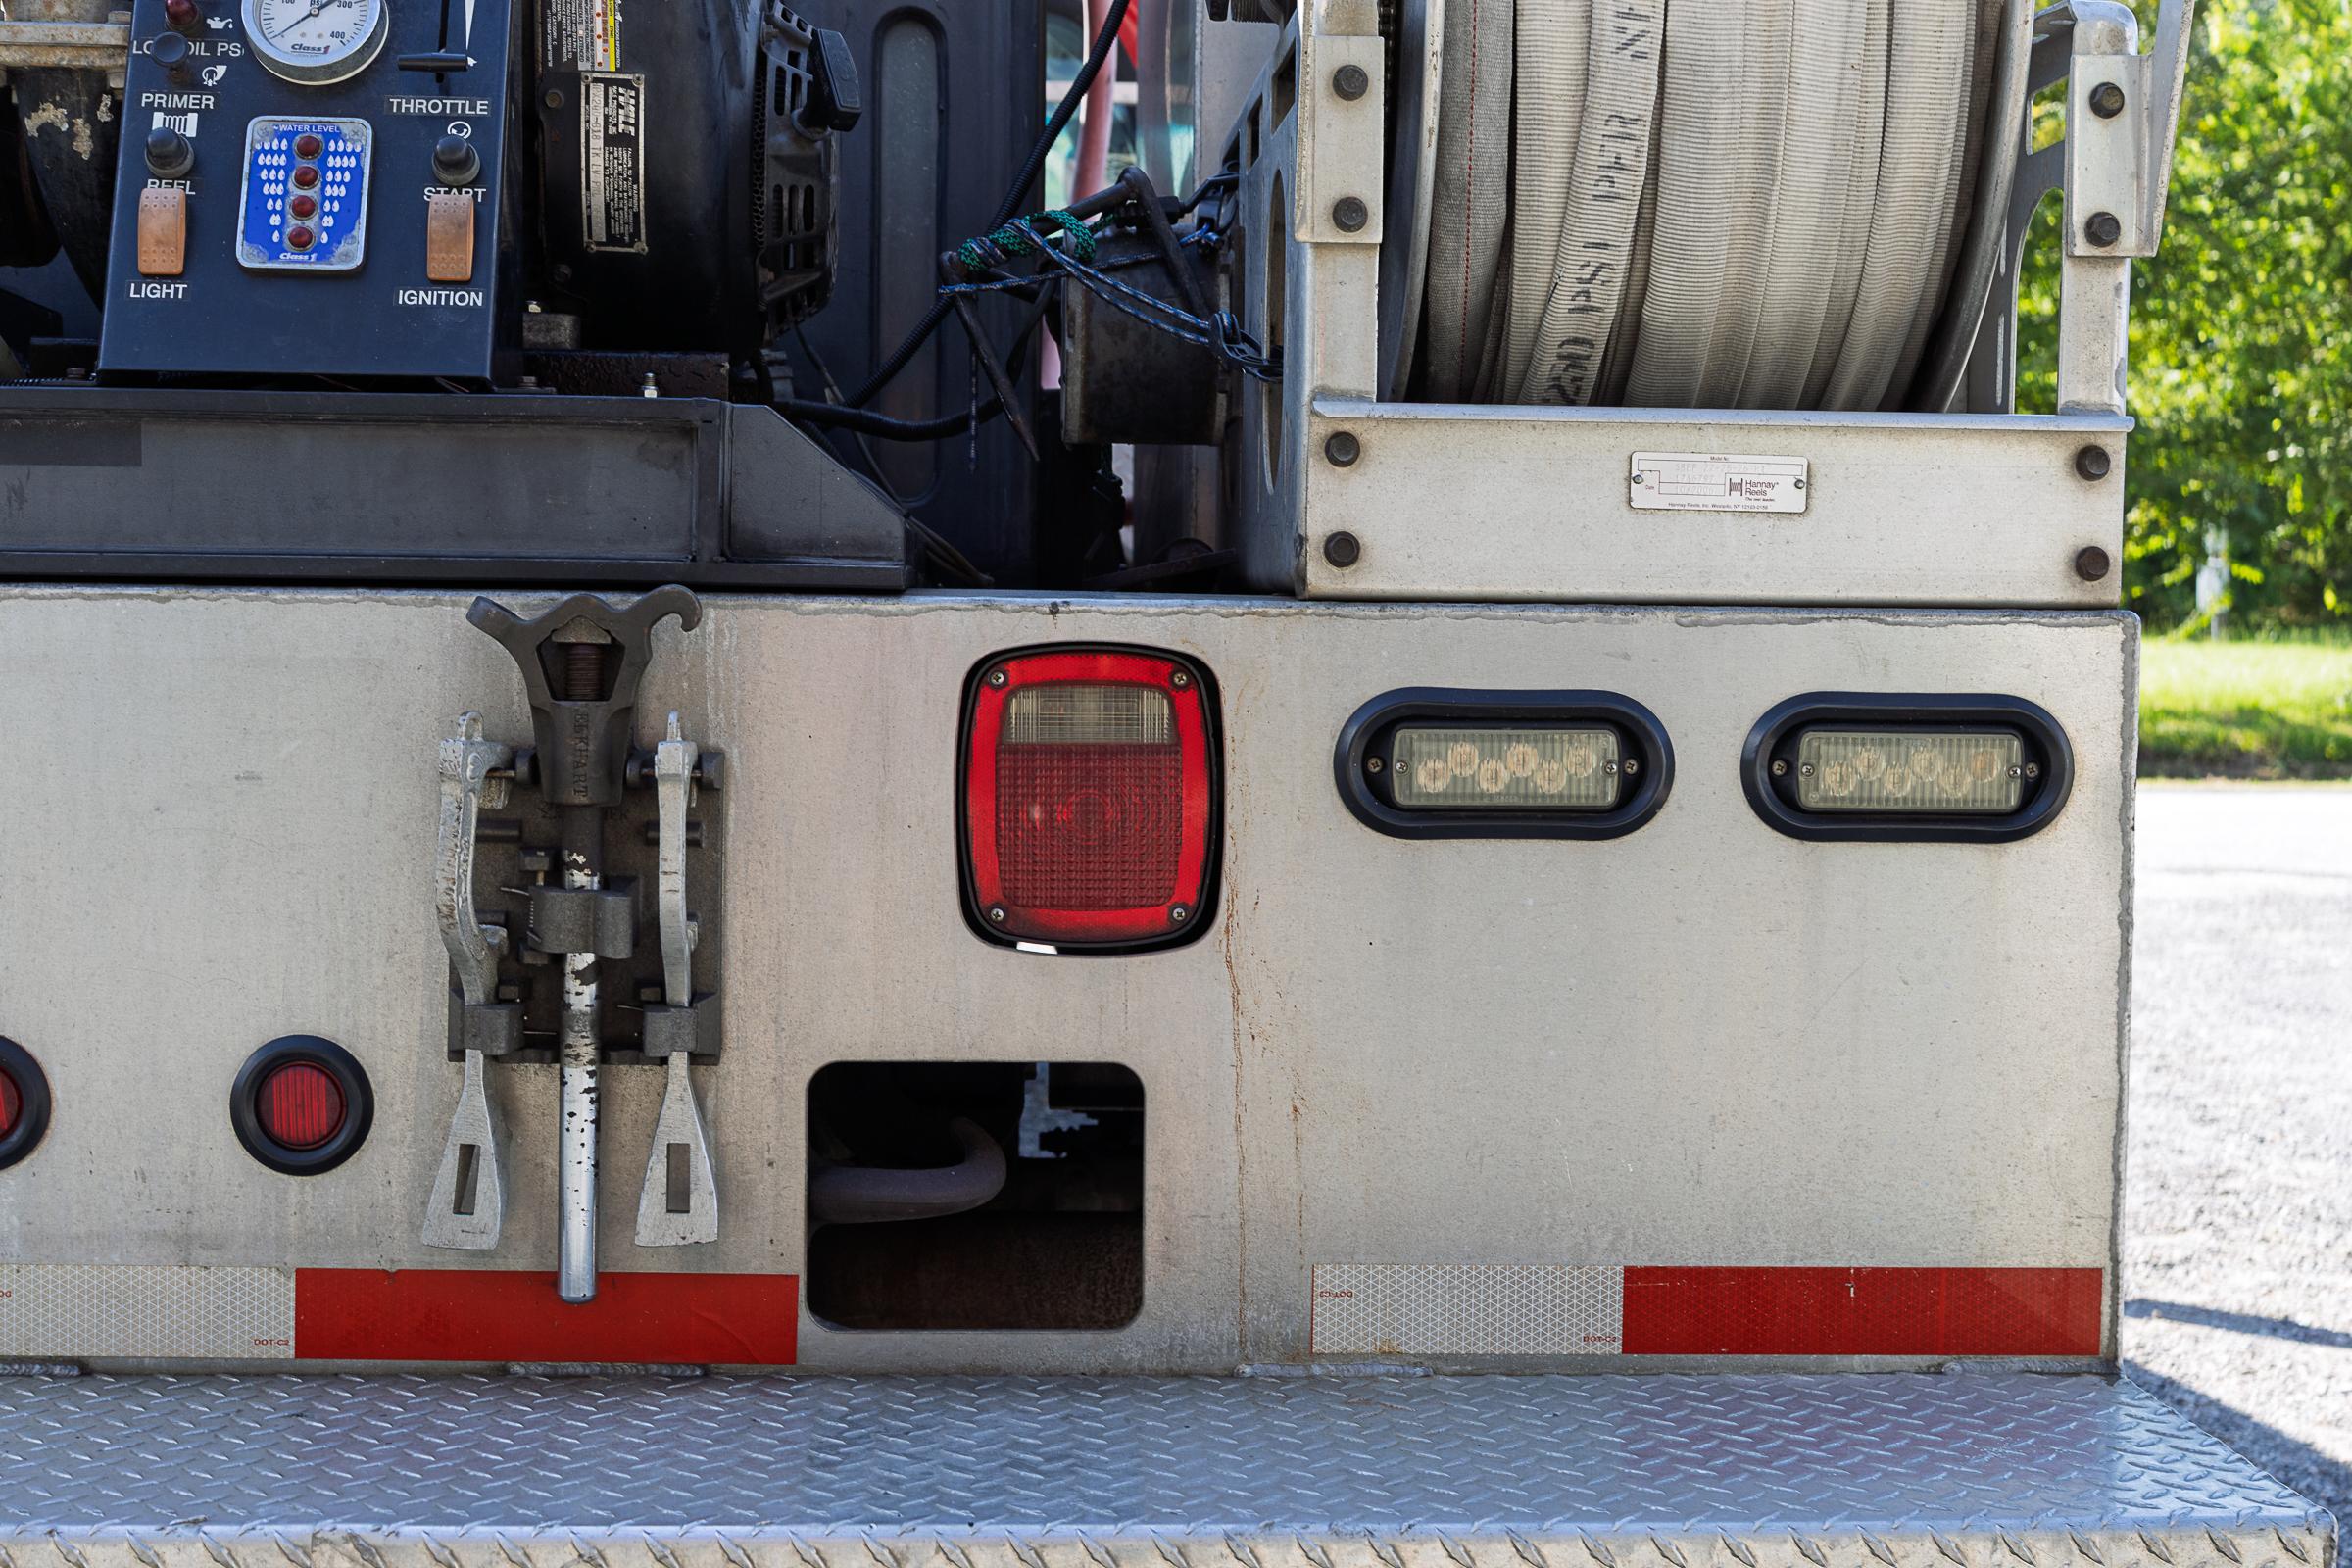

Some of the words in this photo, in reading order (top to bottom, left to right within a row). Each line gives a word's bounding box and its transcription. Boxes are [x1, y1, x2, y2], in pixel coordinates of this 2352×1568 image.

[141, 92, 215, 110] PRIMER
[390, 98, 489, 115] THROTTLE
[618, 86, 636, 136] HALE
[278, 123, 310, 133] WATER
[312, 124, 340, 133] LEVEL
[1591, 113, 1643, 202] PER
[147, 178, 196, 195] REEL
[423, 187, 486, 203] START
[1568, 240, 1620, 314] PSI
[129, 282, 187, 299] LIGHT
[398, 289, 483, 307] IGNITION
[1745, 487, 1768, 496] Reels
[572, 713, 589, 798] ELKHART
